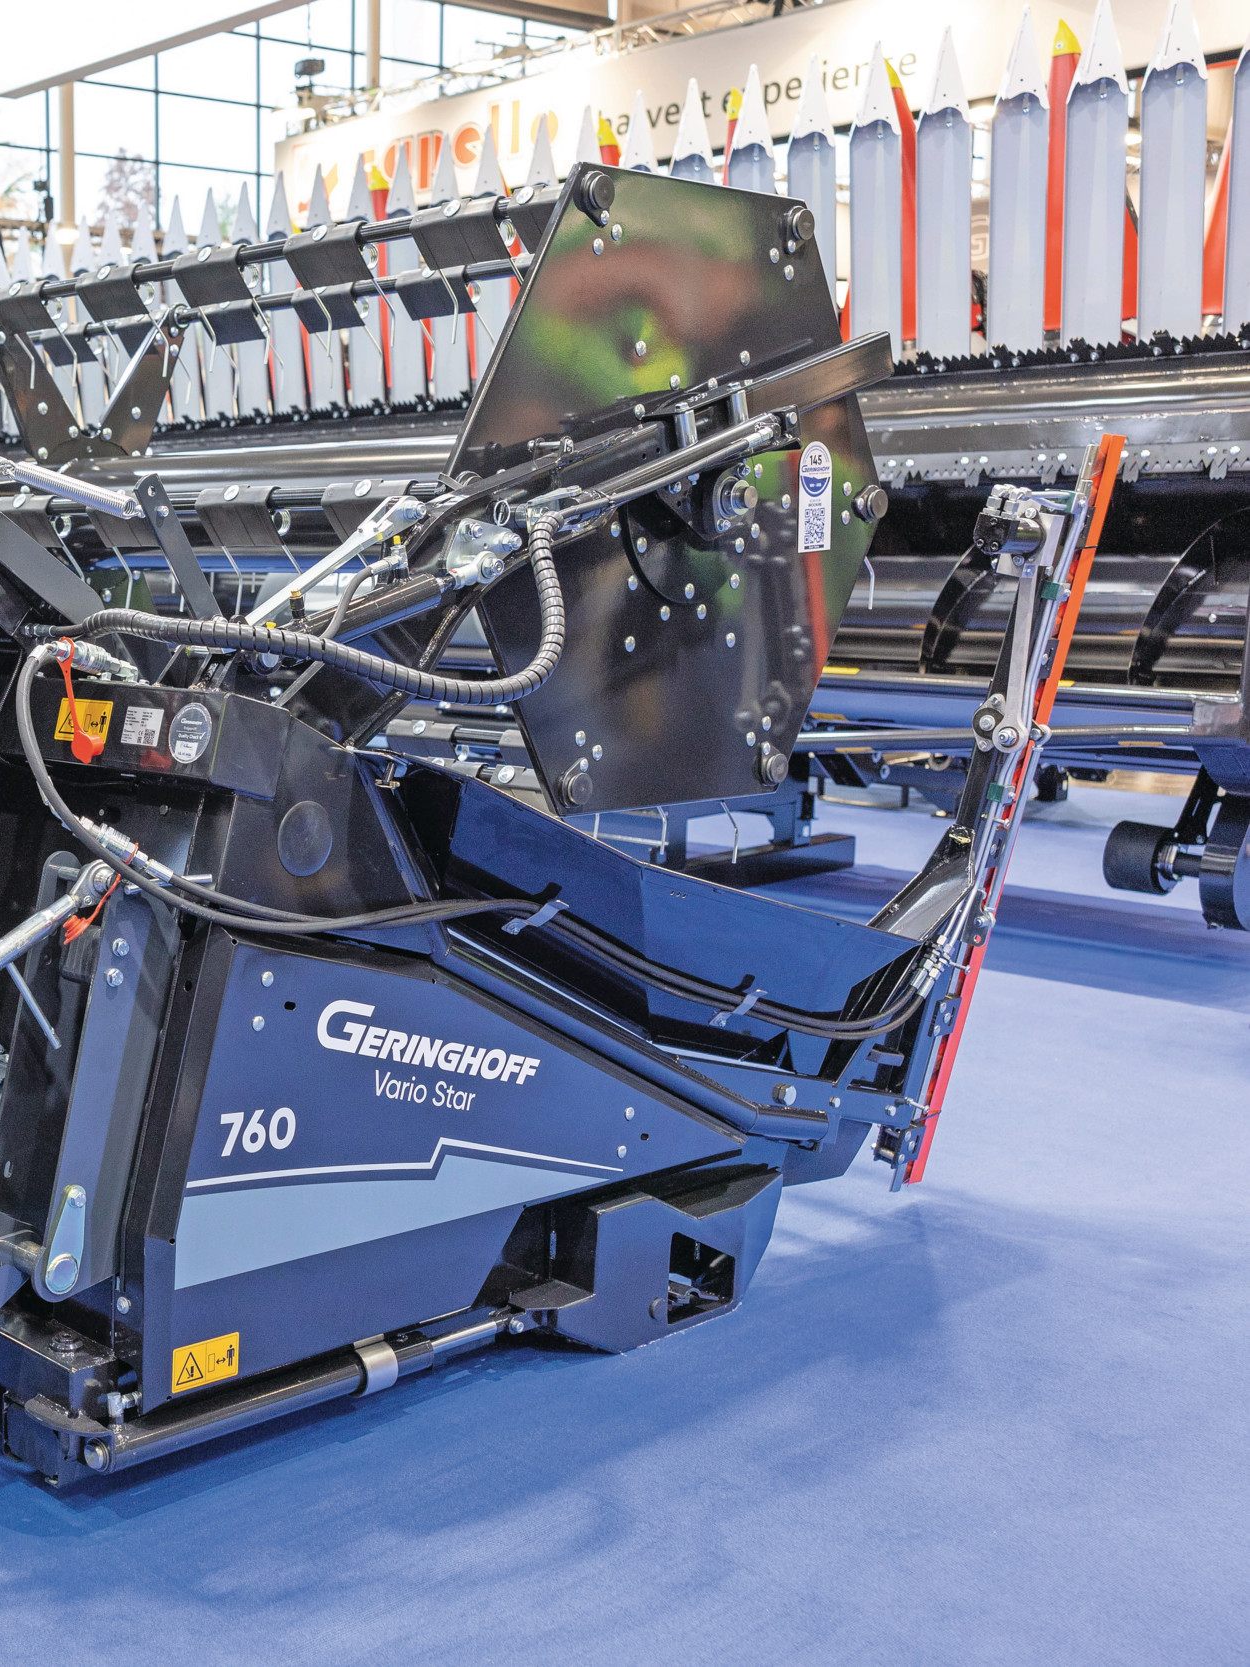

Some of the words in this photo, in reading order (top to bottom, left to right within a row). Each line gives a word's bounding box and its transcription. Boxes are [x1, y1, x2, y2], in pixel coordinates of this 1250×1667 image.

[810, 455, 822, 466] 145
[316, 999, 541, 1085] GERINGHOFF
[375, 1069, 428, 1104] Vario
[432, 1080, 476, 1112] Star
[219, 1107, 296, 1157] 760
